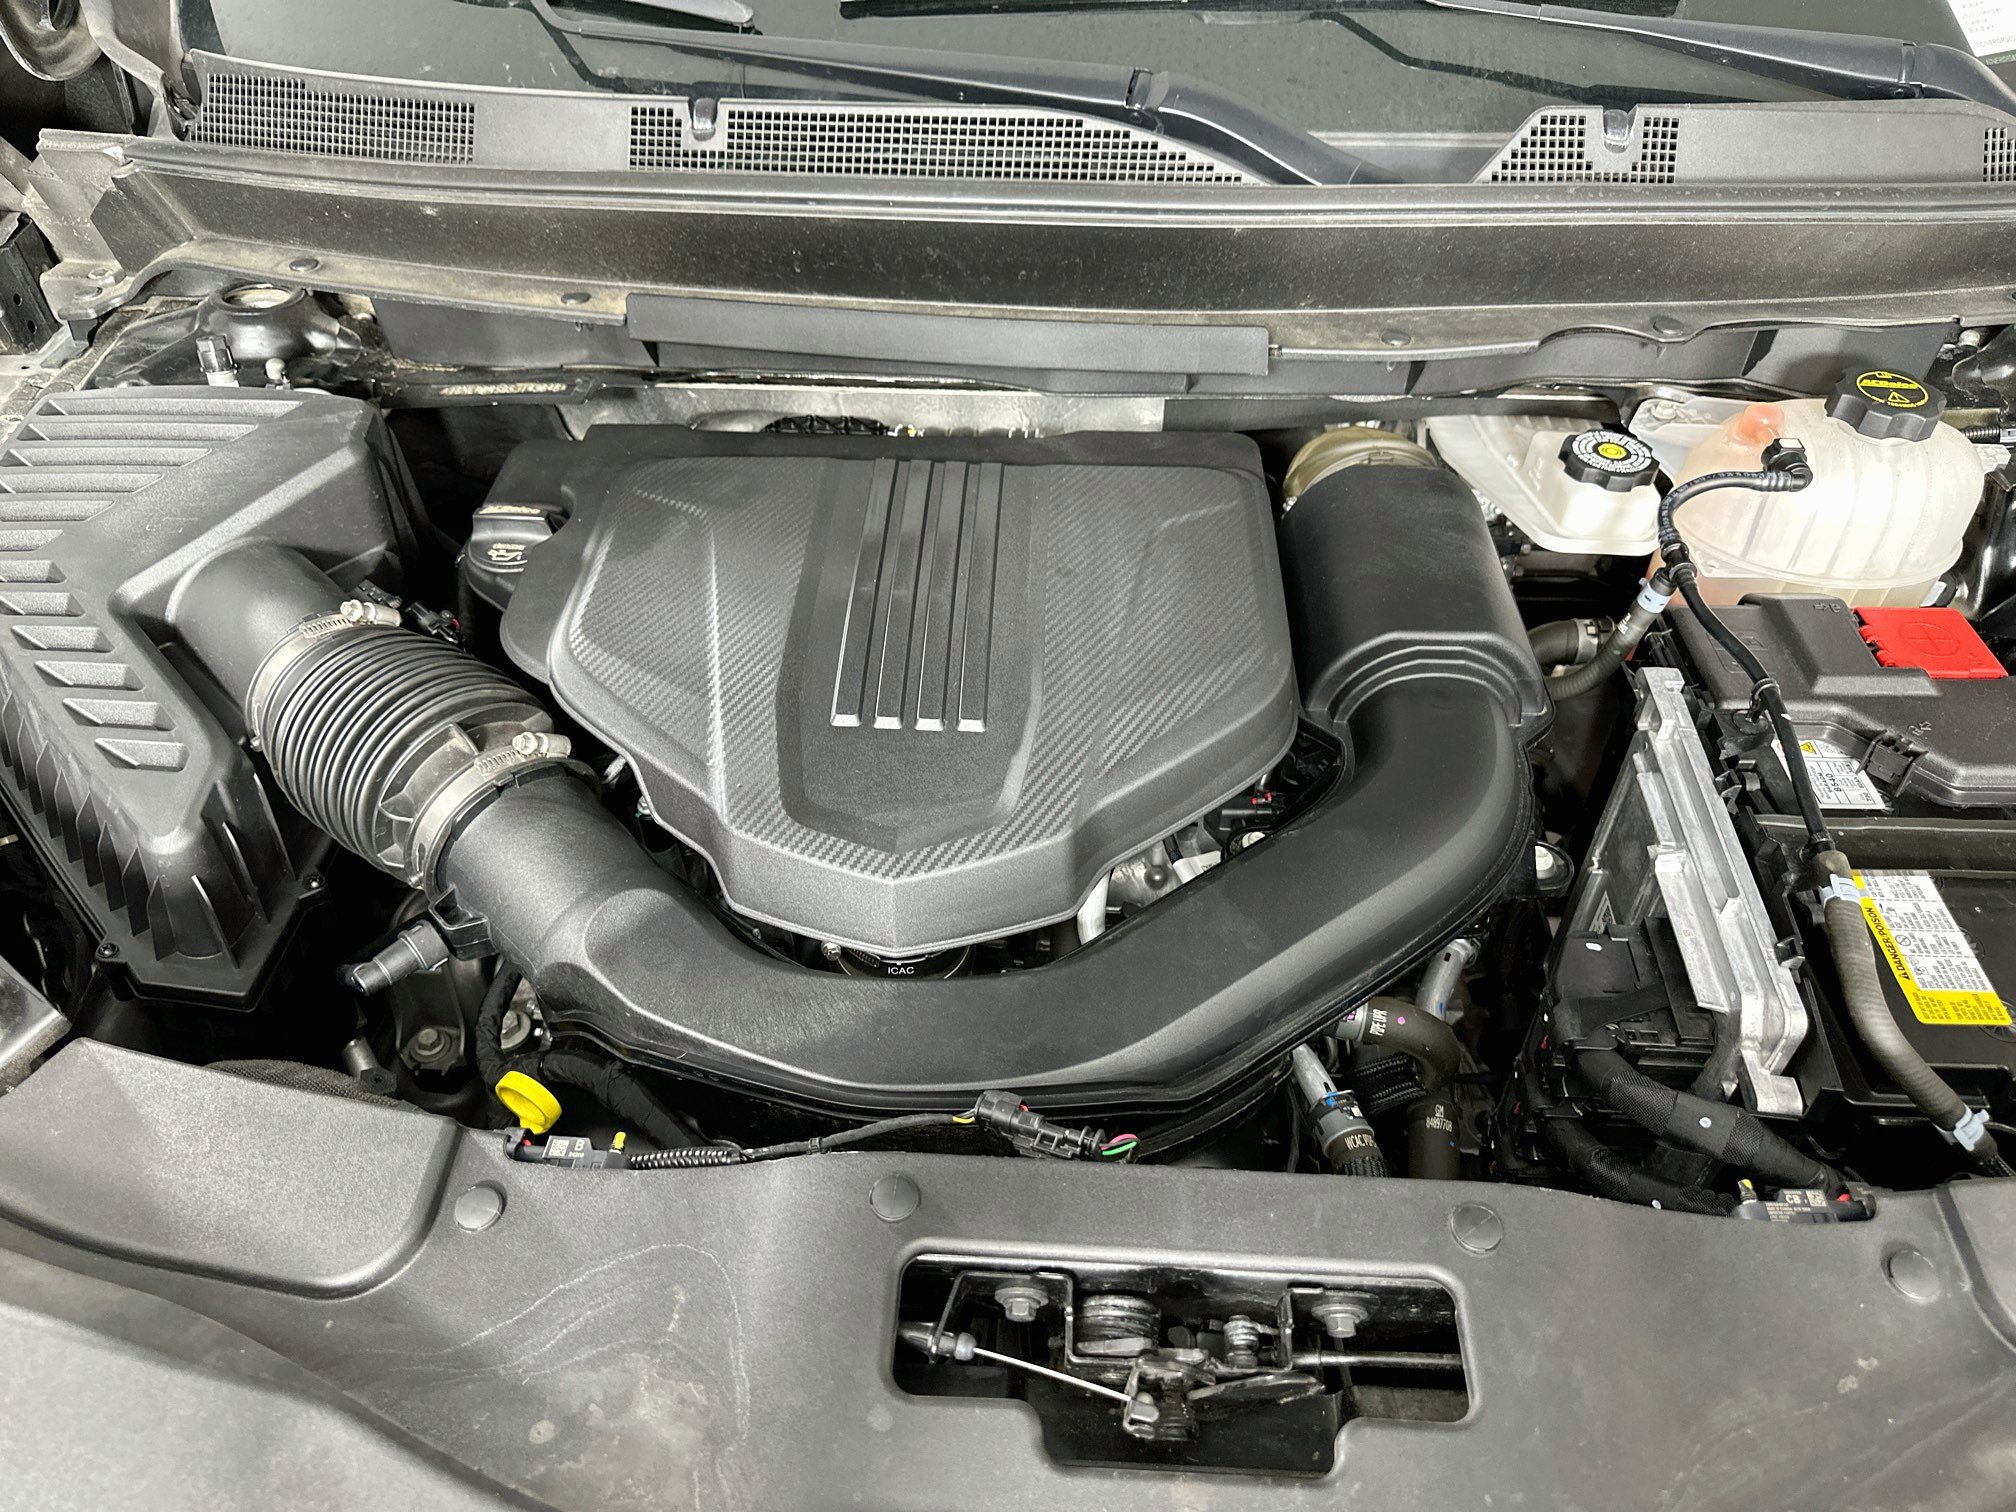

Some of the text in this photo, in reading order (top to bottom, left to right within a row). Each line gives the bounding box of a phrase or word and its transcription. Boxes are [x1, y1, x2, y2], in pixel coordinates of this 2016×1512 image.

[1825, 773, 1842, 792] 8540
[887, 966, 915, 975] ICAC
[1370, 1009, 1387, 1036] PIPE UPR
[1434, 1104, 1445, 1118] GM
[574, 1138, 586, 1151] B
[1785, 1194, 1801, 1205] CB
